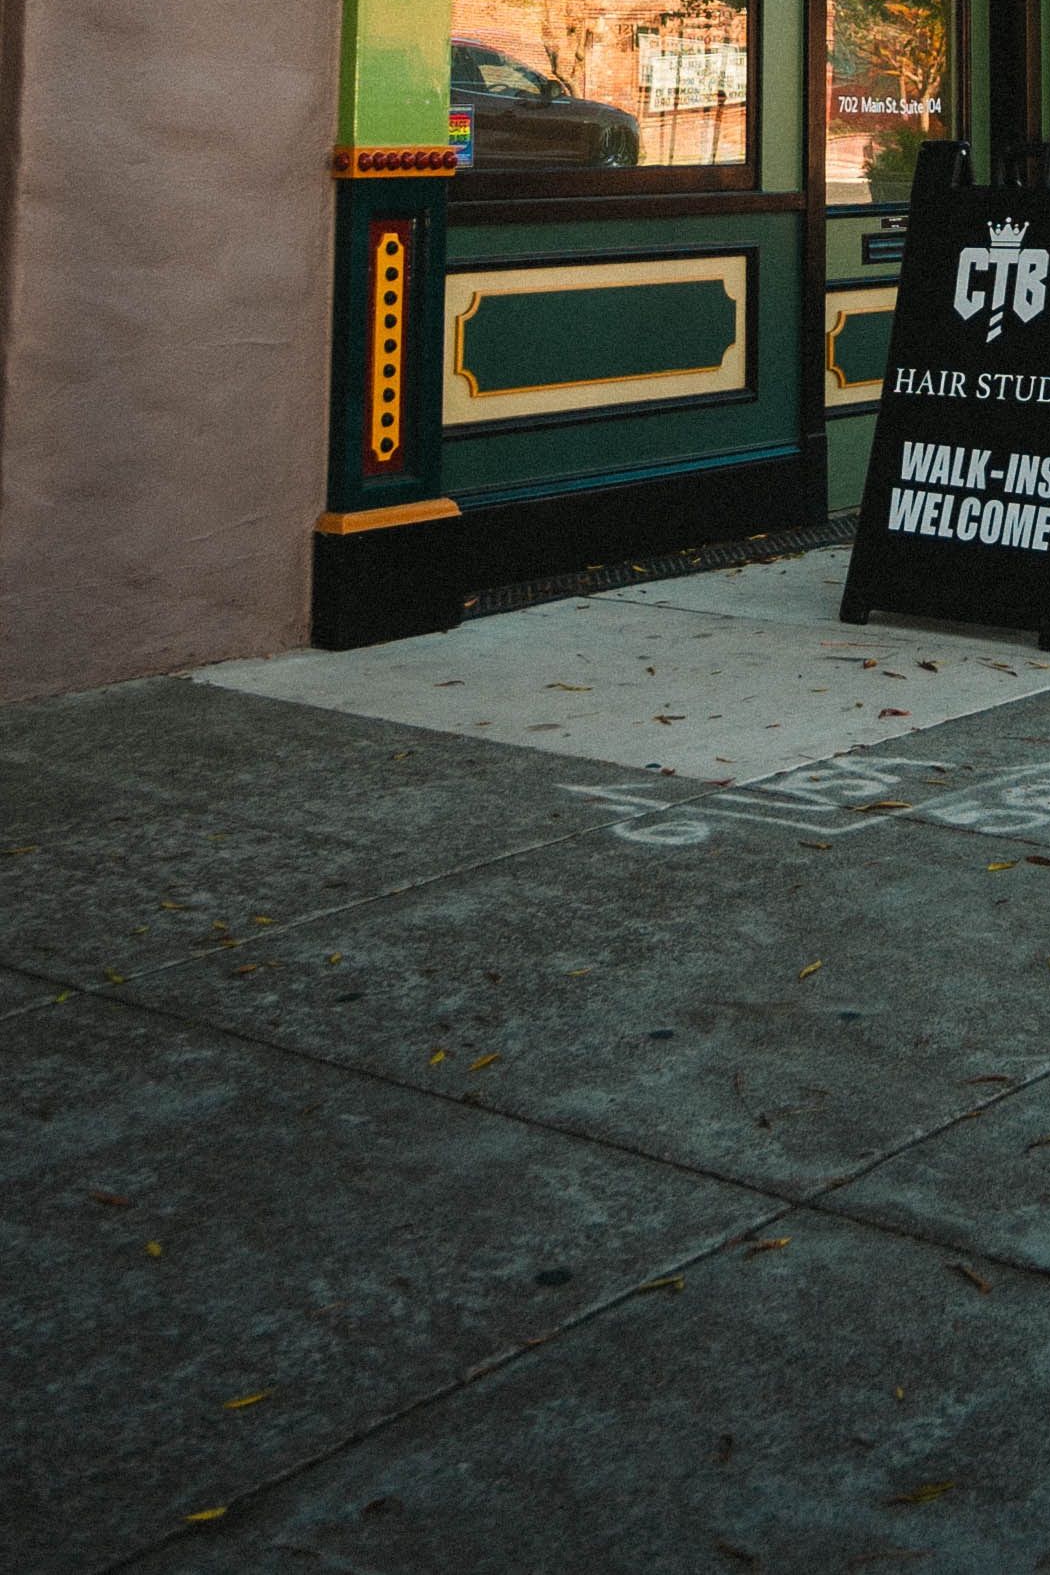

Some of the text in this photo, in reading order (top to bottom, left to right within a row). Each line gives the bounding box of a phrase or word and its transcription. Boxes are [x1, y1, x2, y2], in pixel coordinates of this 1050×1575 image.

[838, 96, 858, 113] 702
[861, 97, 884, 114] Main
[900, 99, 923, 115] Suite
[954, 247, 1049, 332] CTB
[894, 367, 967, 399] HAIR
